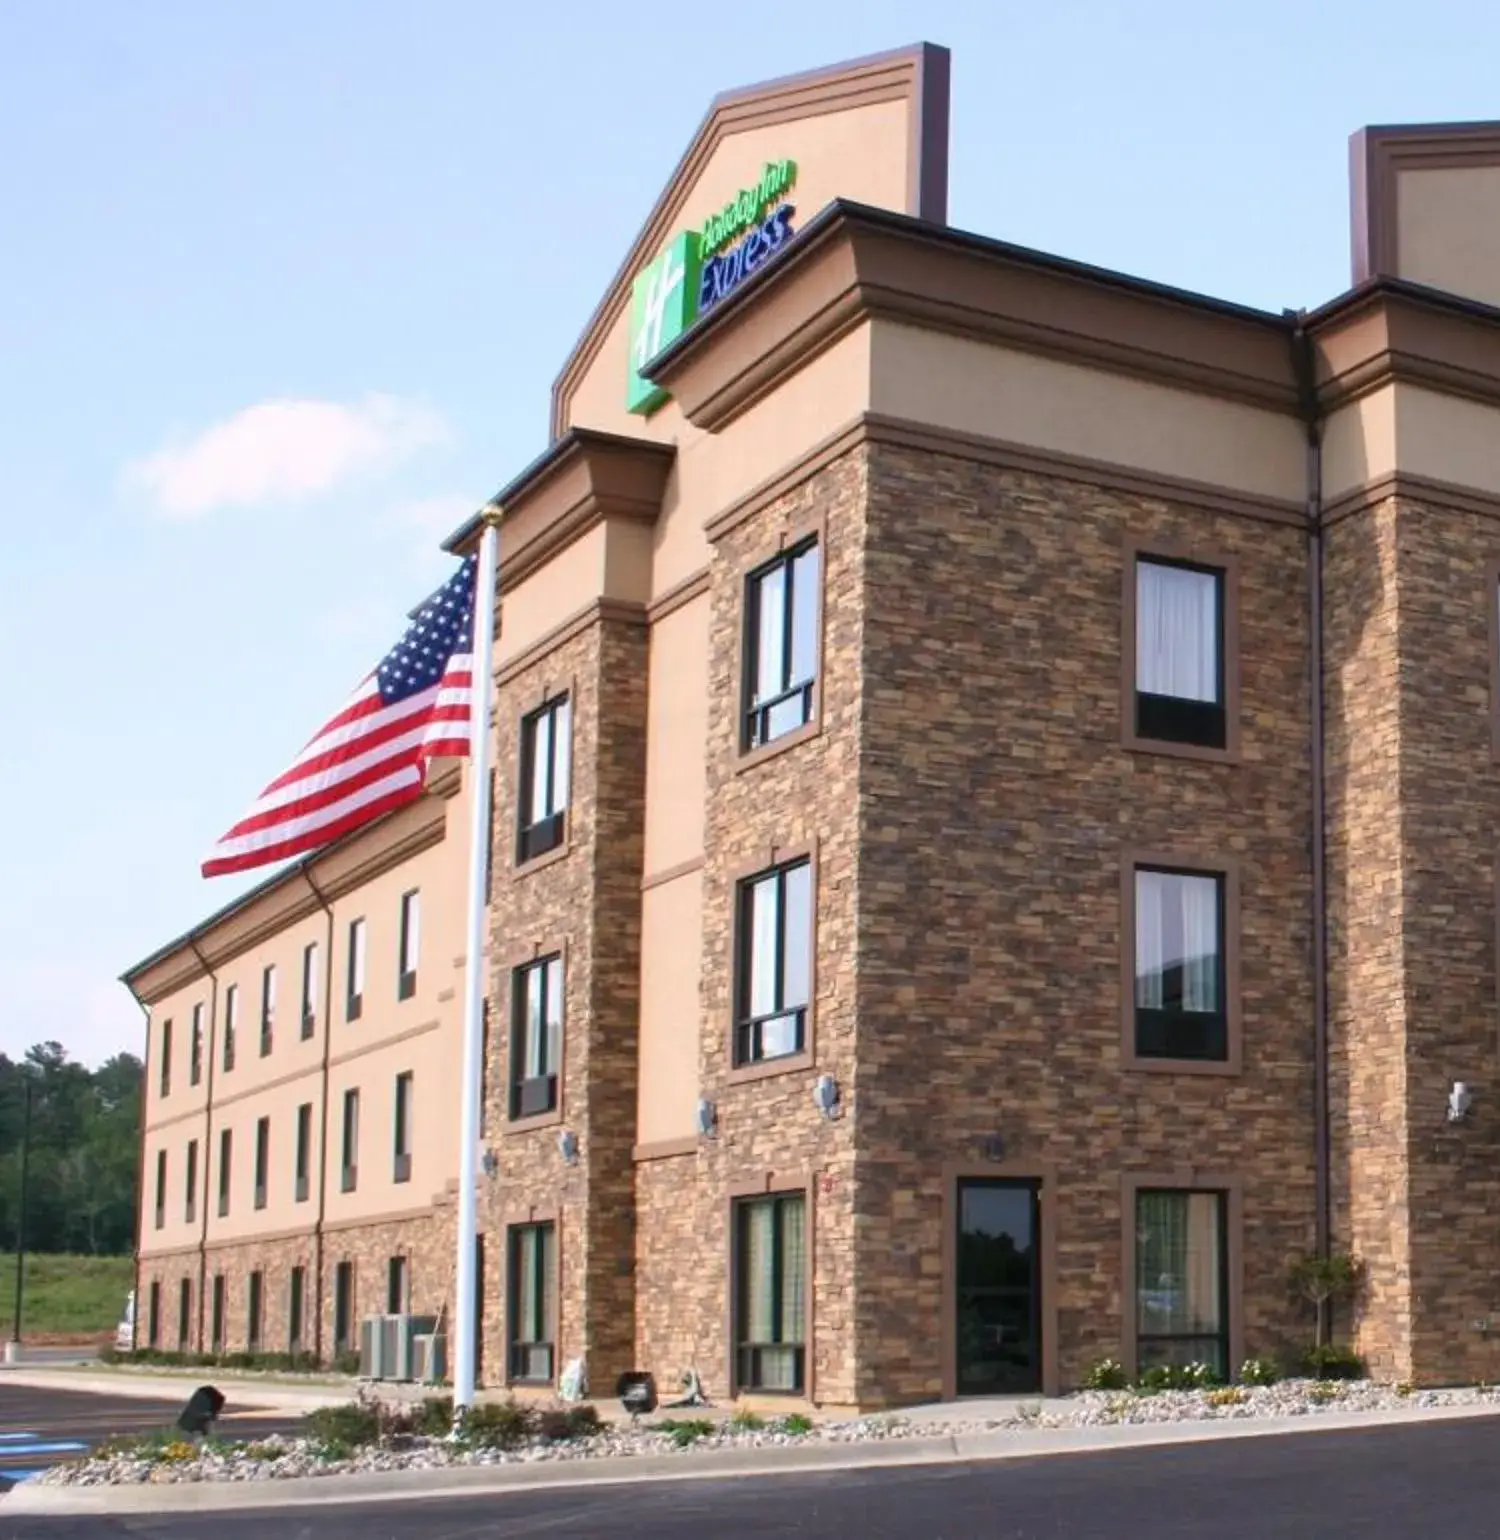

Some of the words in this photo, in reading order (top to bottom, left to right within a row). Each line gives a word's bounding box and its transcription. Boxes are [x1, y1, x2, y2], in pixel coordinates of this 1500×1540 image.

[698, 189, 761, 261] Holiday
[760, 159, 797, 203] Inn
[699, 203, 797, 316] Express
